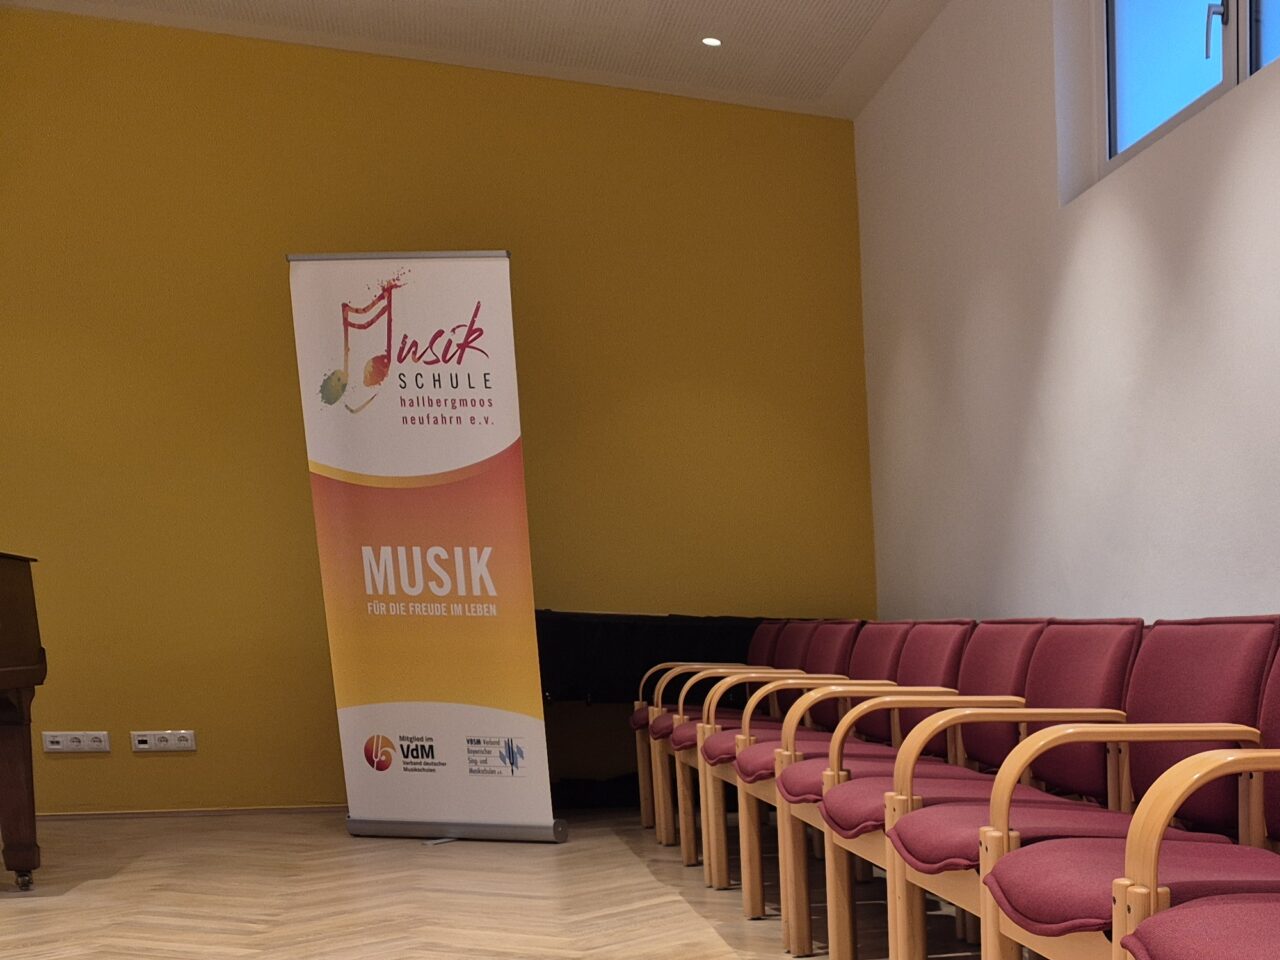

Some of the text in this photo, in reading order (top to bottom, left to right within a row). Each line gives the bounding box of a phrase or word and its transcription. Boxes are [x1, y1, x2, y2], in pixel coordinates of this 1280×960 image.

[399, 372, 492, 389] SCHULE
[400, 396, 493, 410] hallbergmoos
[402, 413, 462, 425] neufahrn
[361, 545, 497, 596] MUSIK
[368, 600, 497, 616] FÜR DIE FREUDE IM LEBEN
[399, 735, 424, 744] Mitglied
[400, 744, 435, 760] VdM
